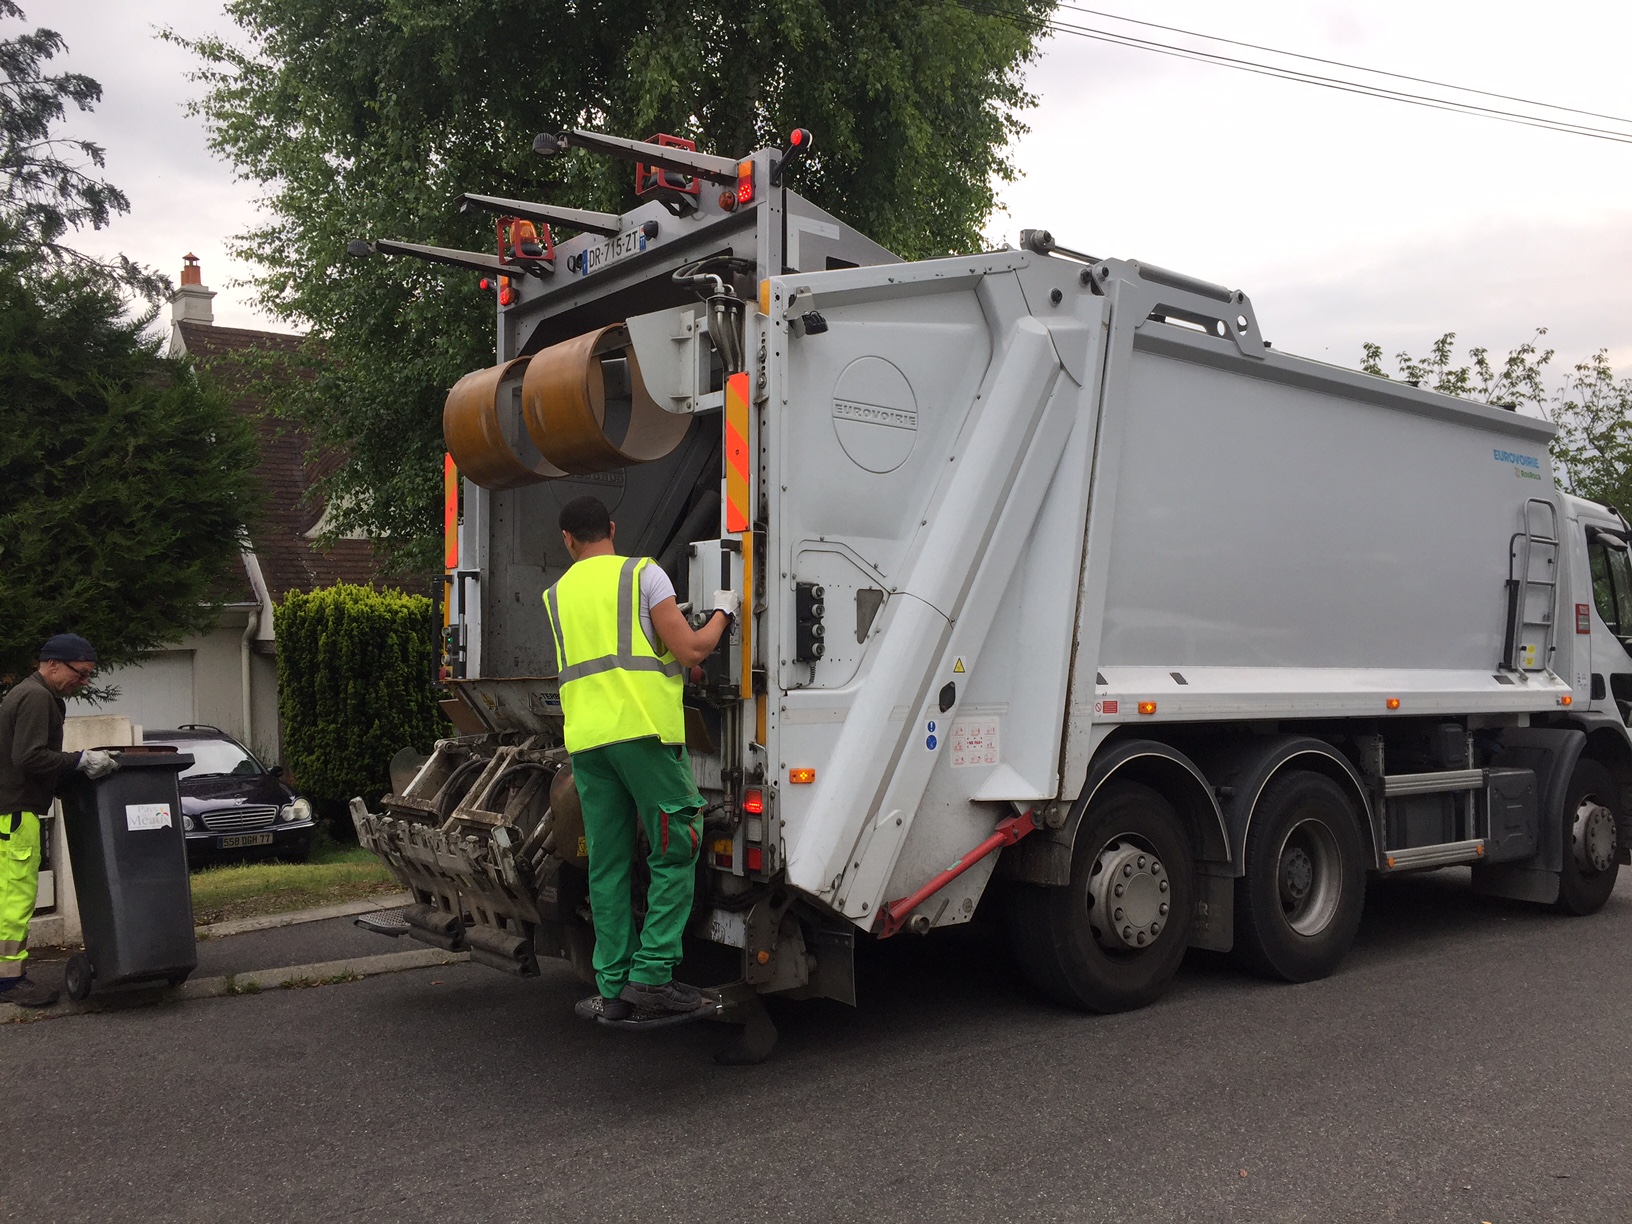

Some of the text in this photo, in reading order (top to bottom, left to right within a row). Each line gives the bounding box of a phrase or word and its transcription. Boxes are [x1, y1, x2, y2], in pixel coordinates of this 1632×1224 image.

[589, 230, 638, 268] DR-715-ZT
[835, 403, 917, 427] EUROVOIRIE
[1493, 449, 1540, 469] EUROVOIRIE
[129, 815, 171, 826] Meaux
[223, 834, 271, 847] 558 DGH 77
